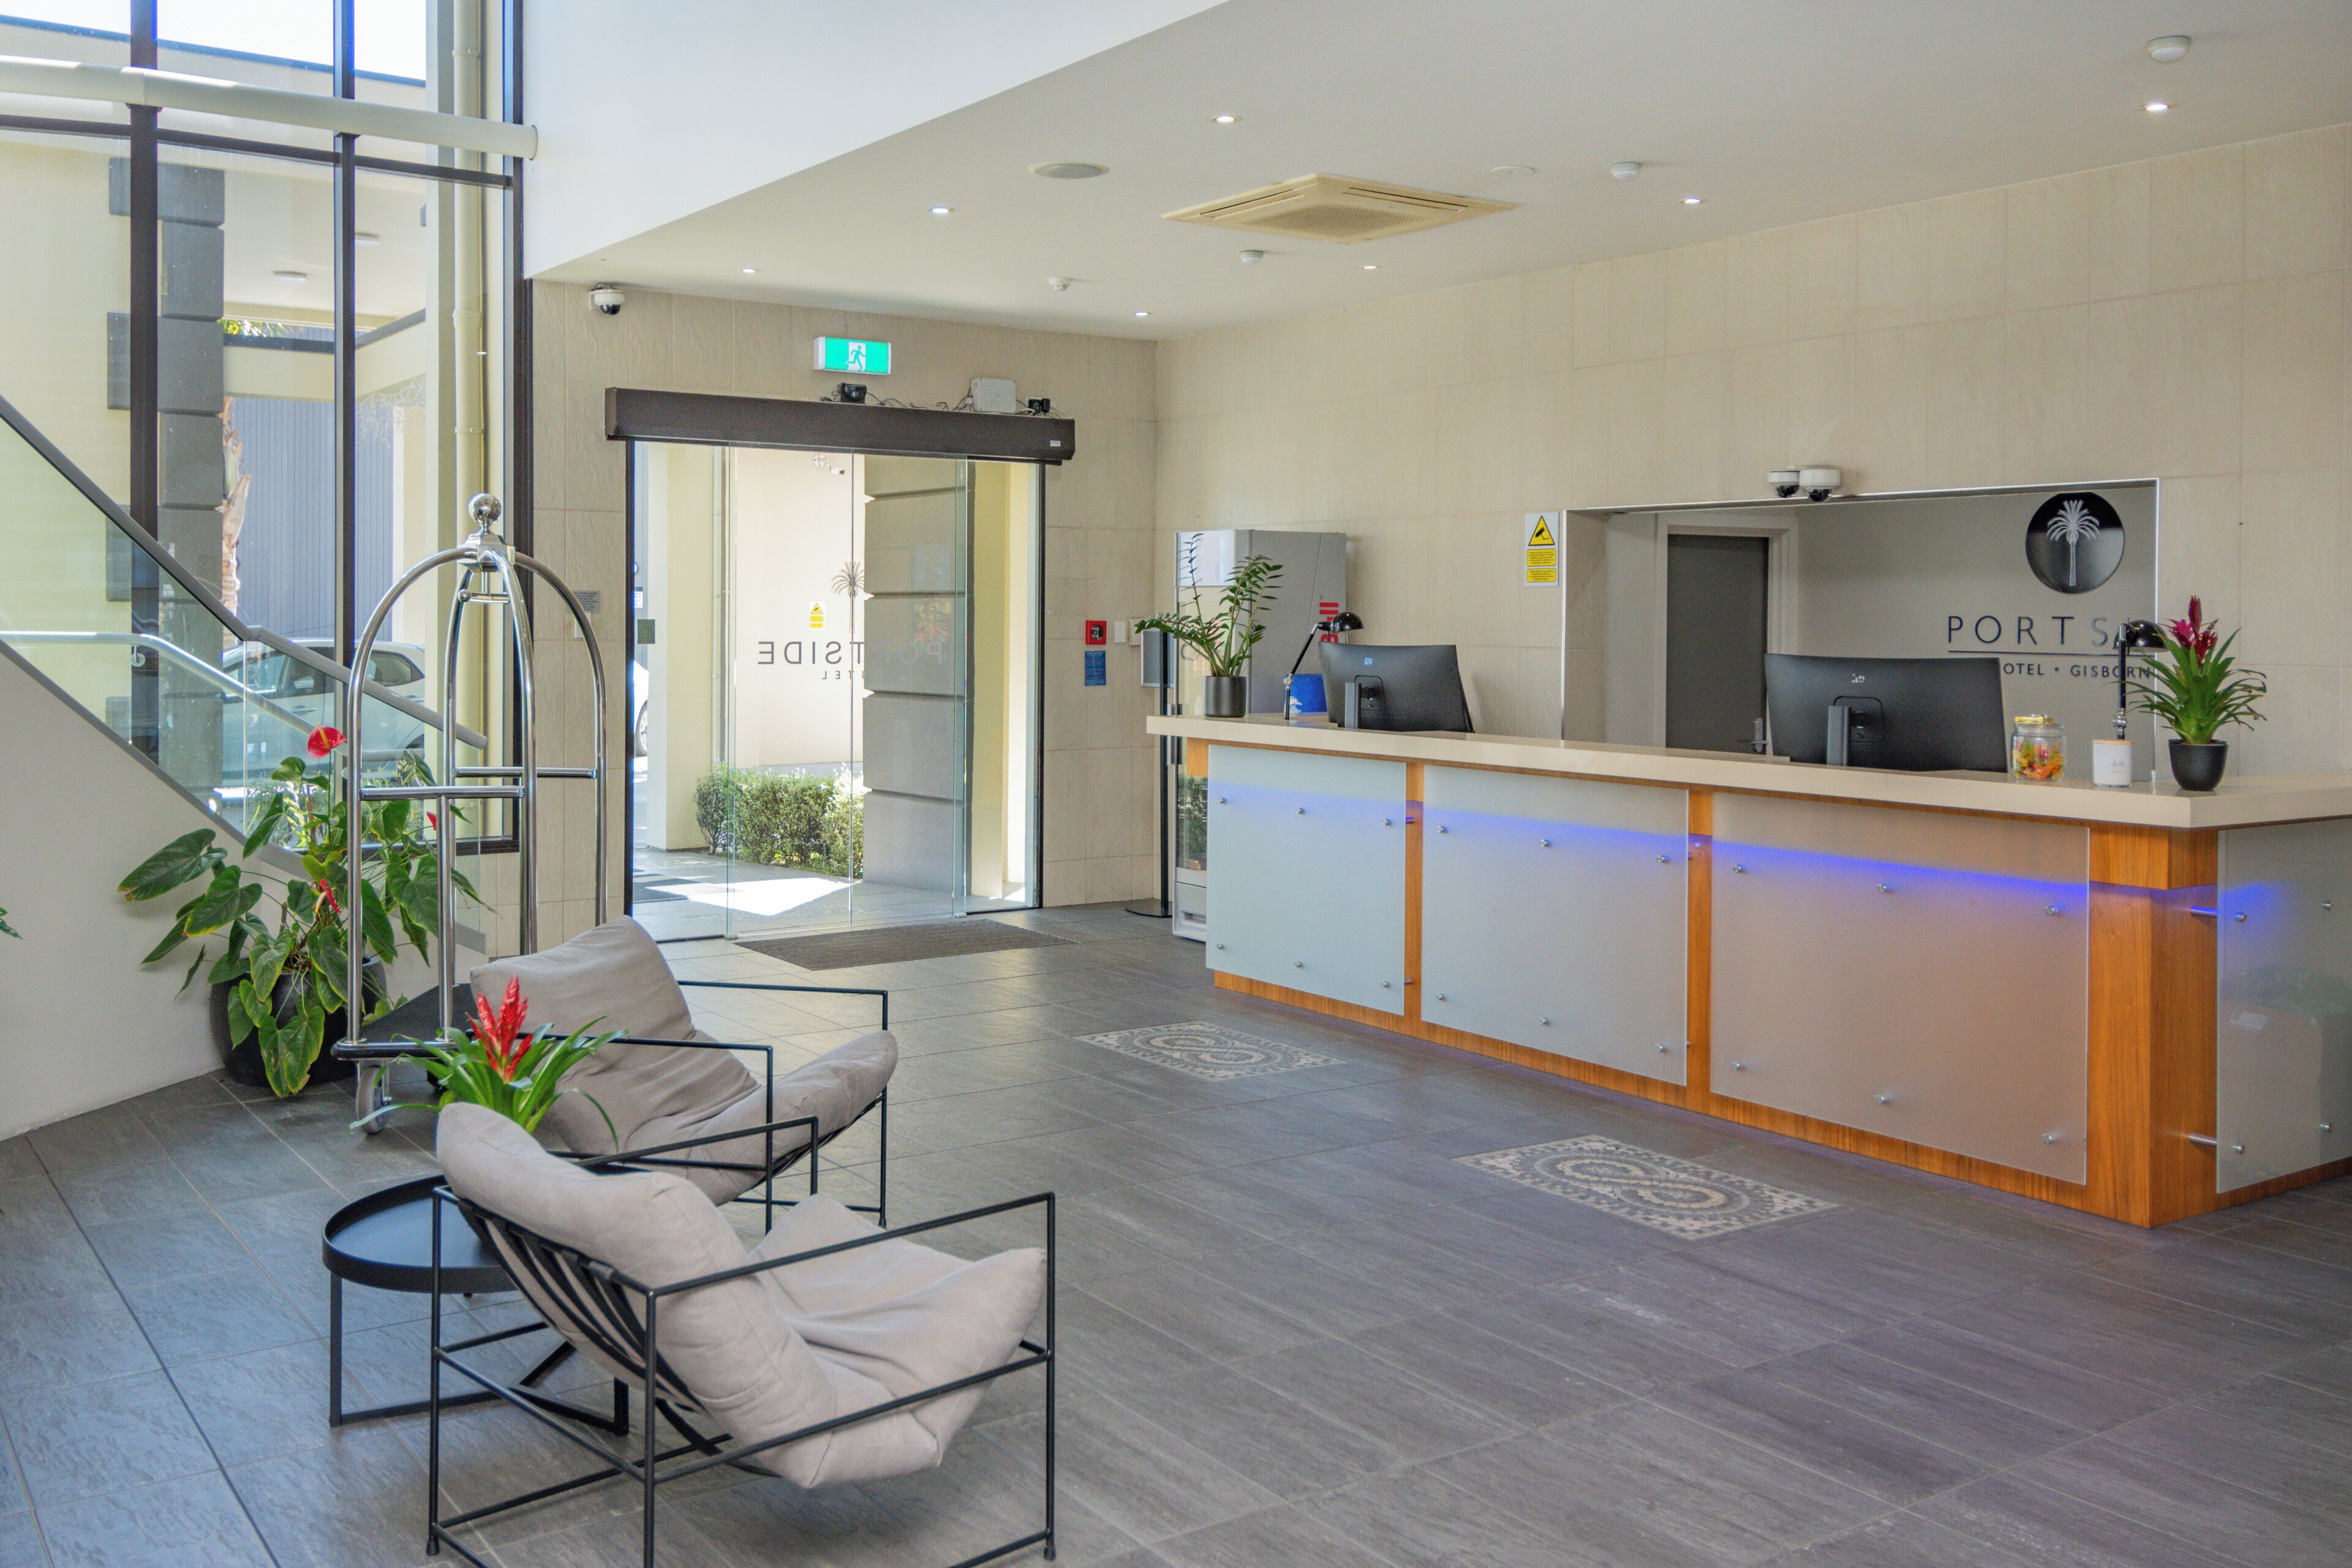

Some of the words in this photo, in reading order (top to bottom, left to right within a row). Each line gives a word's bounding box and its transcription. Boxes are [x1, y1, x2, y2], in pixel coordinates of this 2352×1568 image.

[1948, 616, 2130, 646] PORTS
[2003, 663, 2045, 675] OTEL
[2070, 665, 2155, 678] GISBORN
